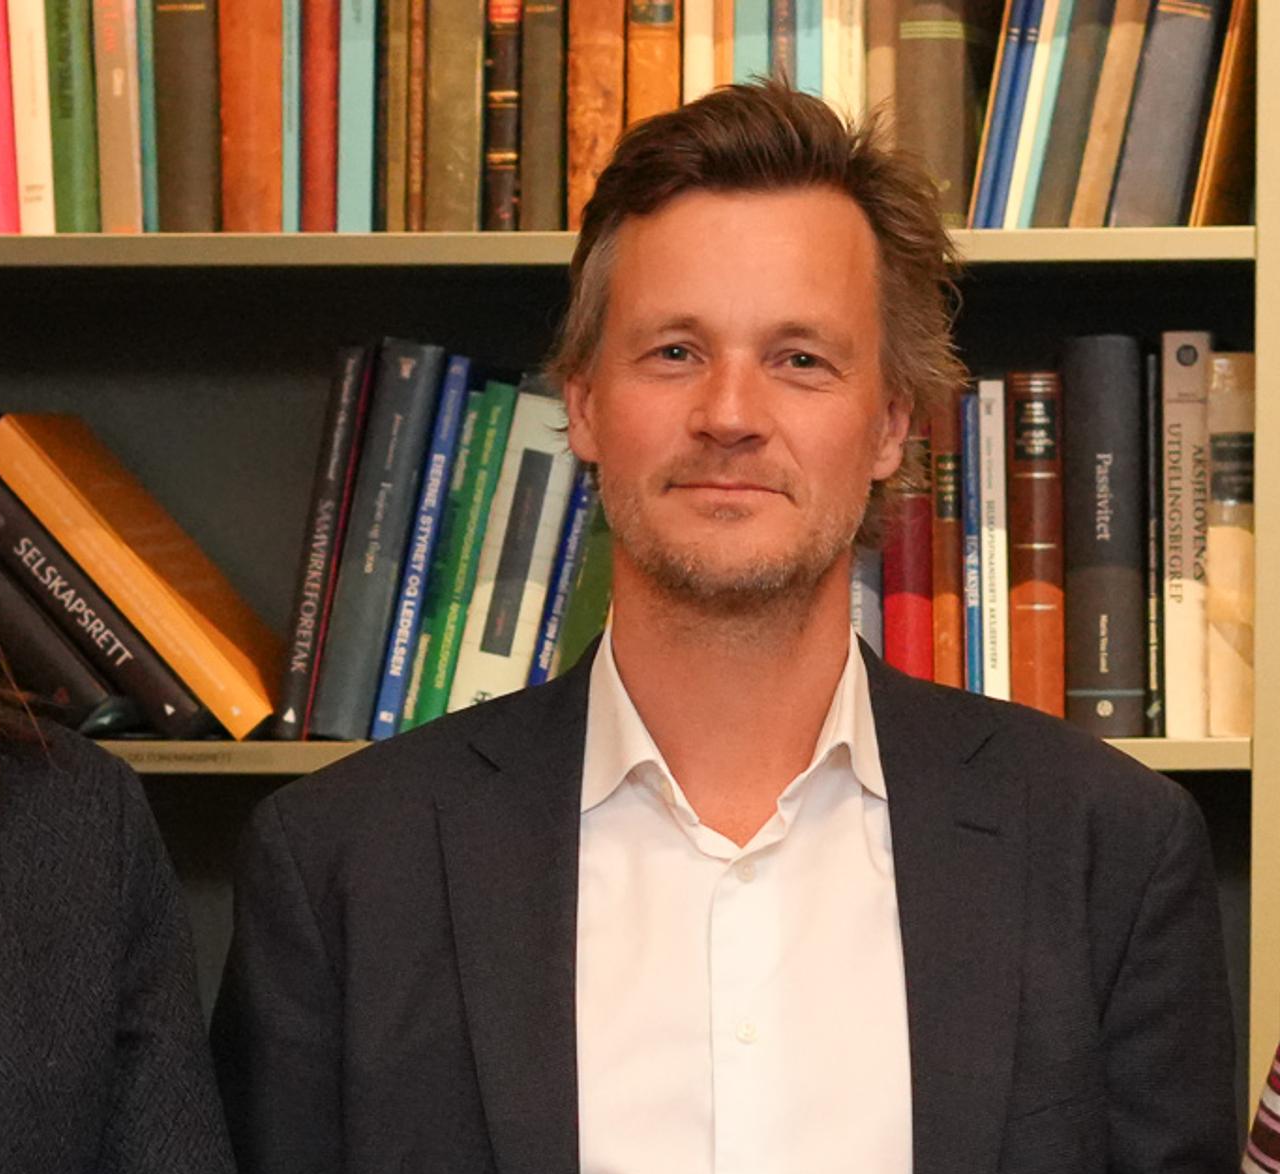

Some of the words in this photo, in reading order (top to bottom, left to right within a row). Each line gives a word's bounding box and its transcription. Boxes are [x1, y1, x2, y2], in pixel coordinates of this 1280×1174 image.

[421, 453, 446, 513] EIERNE,
[1094, 452, 1115, 541] Passivitet
[1166, 423, 1184, 605] UTDELINGSBEGREP
[409, 515, 434, 571] STYRET
[13, 537, 135, 669] SELSKAPSRETT
[291, 499, 336, 674] SAMVIRKEFORETAK
[404, 575, 422, 597] OG
[389, 600, 416, 677] LEDELSEN
